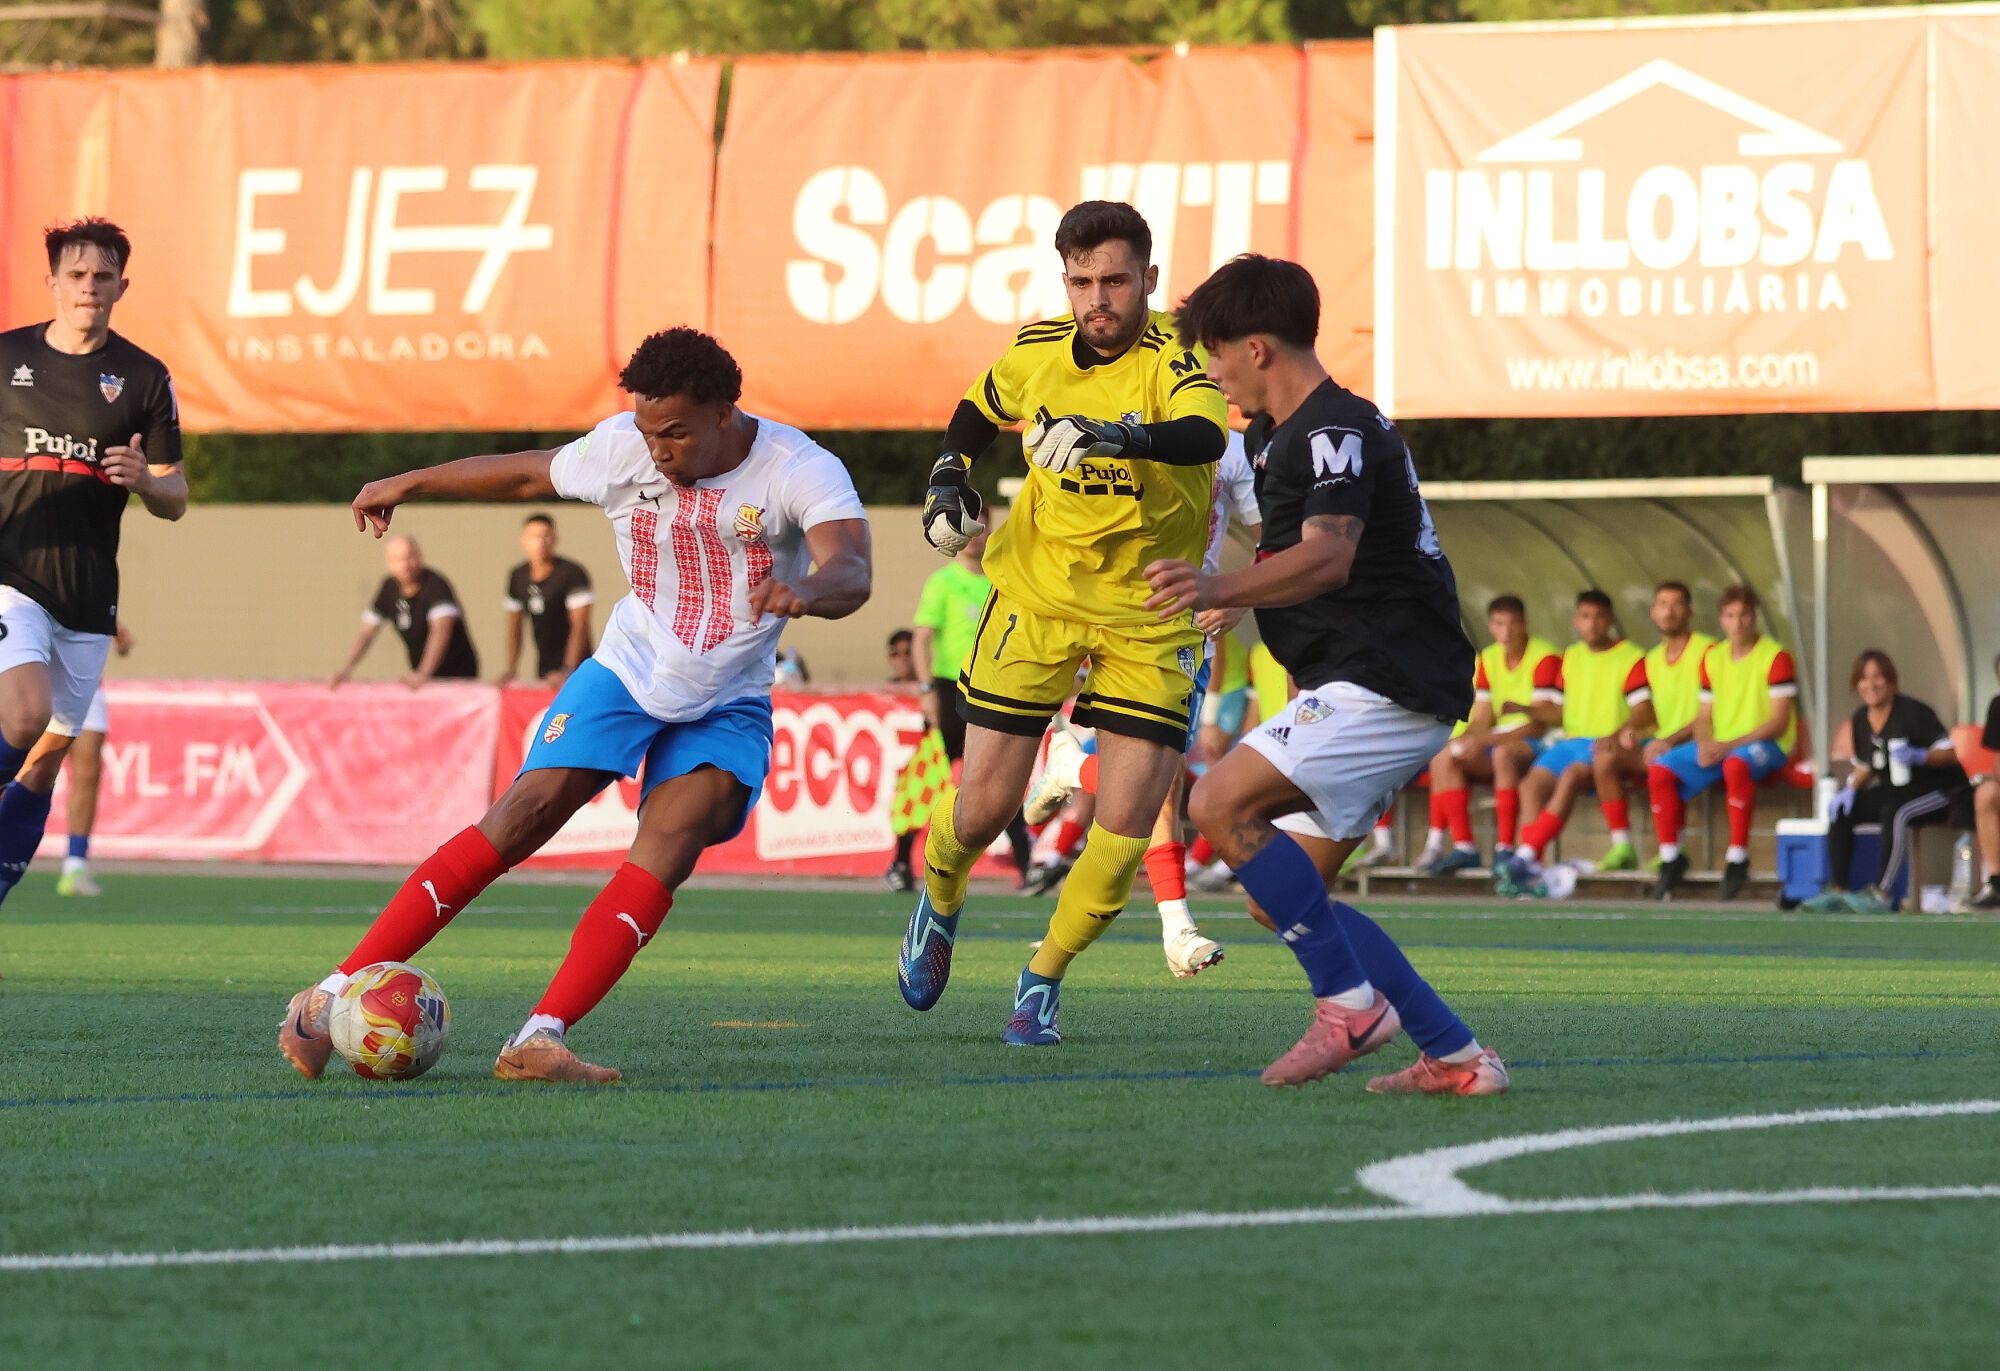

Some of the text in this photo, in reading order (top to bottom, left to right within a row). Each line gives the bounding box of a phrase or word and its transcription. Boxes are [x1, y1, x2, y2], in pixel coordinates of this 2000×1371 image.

[1425, 160, 1894, 271] INLLOBSA
[228, 166, 553, 316] EJE7
[225, 332, 551, 362] INSTALADORA
[1505, 349, 1818, 390] www.inllobsa.com
[24, 427, 98, 462] Pujol
[1310, 432, 1364, 478] M
